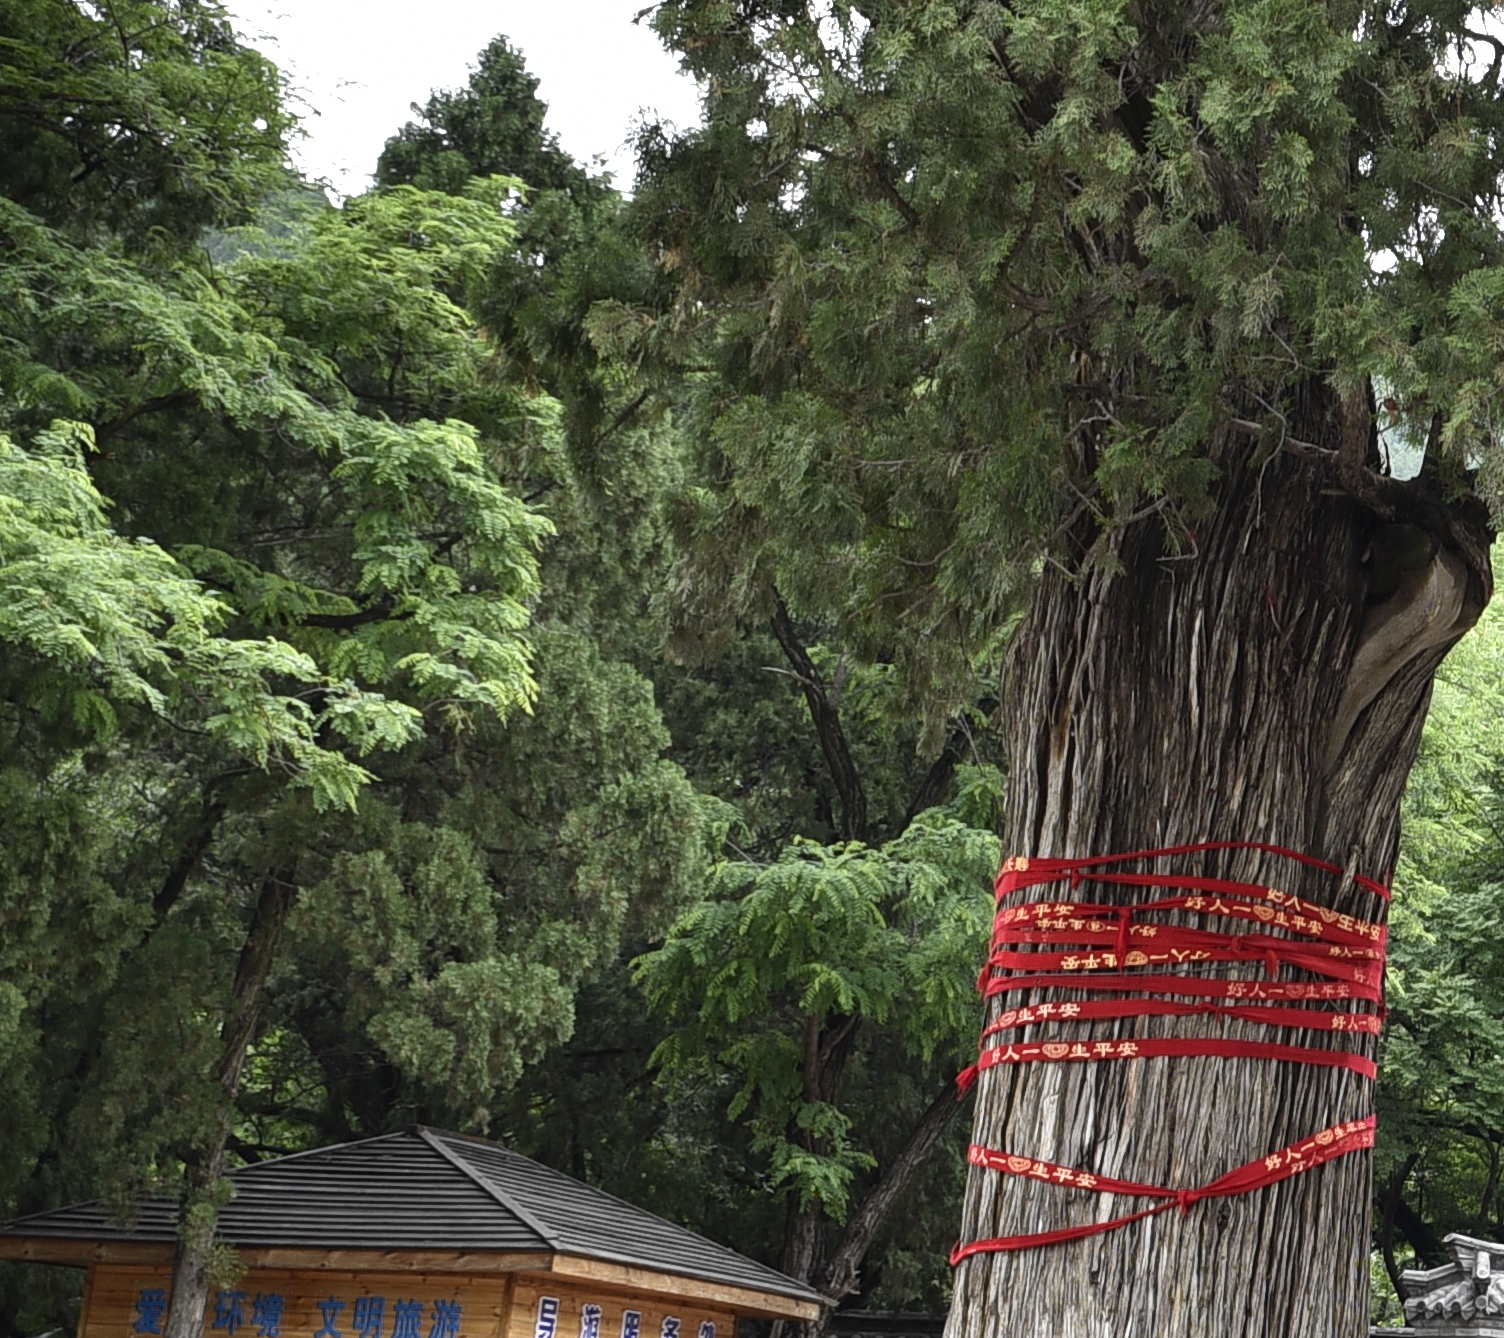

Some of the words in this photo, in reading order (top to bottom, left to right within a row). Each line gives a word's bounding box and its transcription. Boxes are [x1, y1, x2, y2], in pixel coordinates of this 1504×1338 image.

[1184, 896, 1324, 936] 好人一生平安
[1226, 981, 1351, 999] 好人一生平安
[991, 1042, 1139, 1064] 好人一生平安
[969, 1146, 1098, 1188] 好人一生平安
